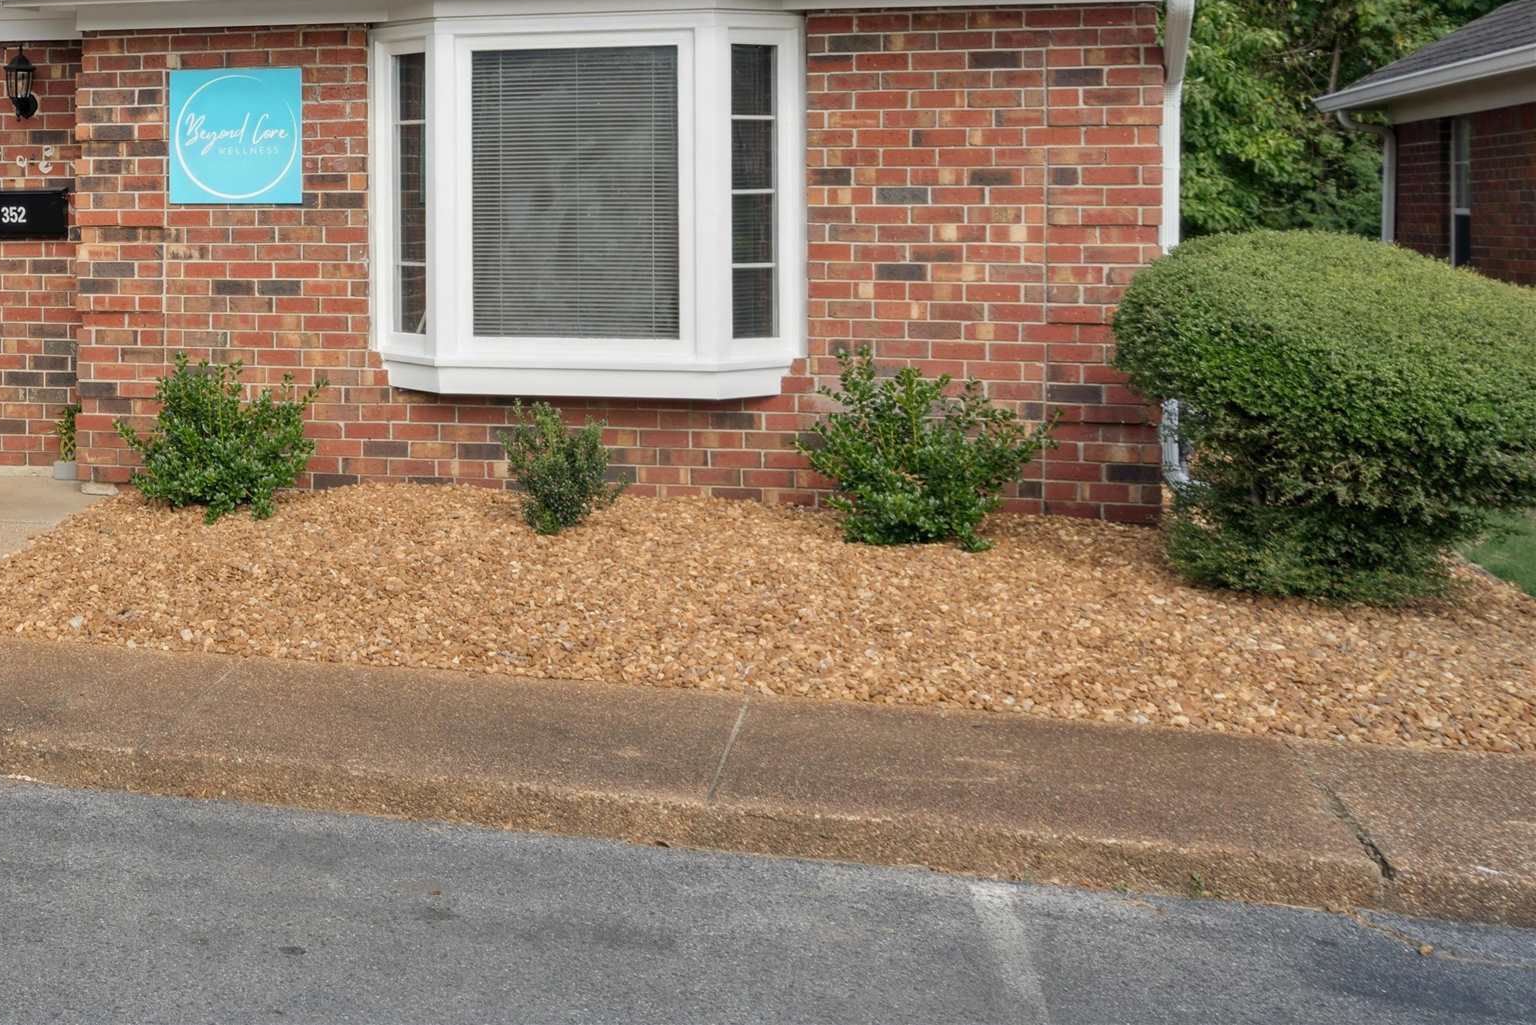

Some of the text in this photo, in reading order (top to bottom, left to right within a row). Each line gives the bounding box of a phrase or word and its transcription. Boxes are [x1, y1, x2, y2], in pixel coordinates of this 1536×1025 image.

[185, 112, 250, 156] Beyond
[218, 146, 279, 155] WELLNESS
[1, 206, 27, 223] 352
